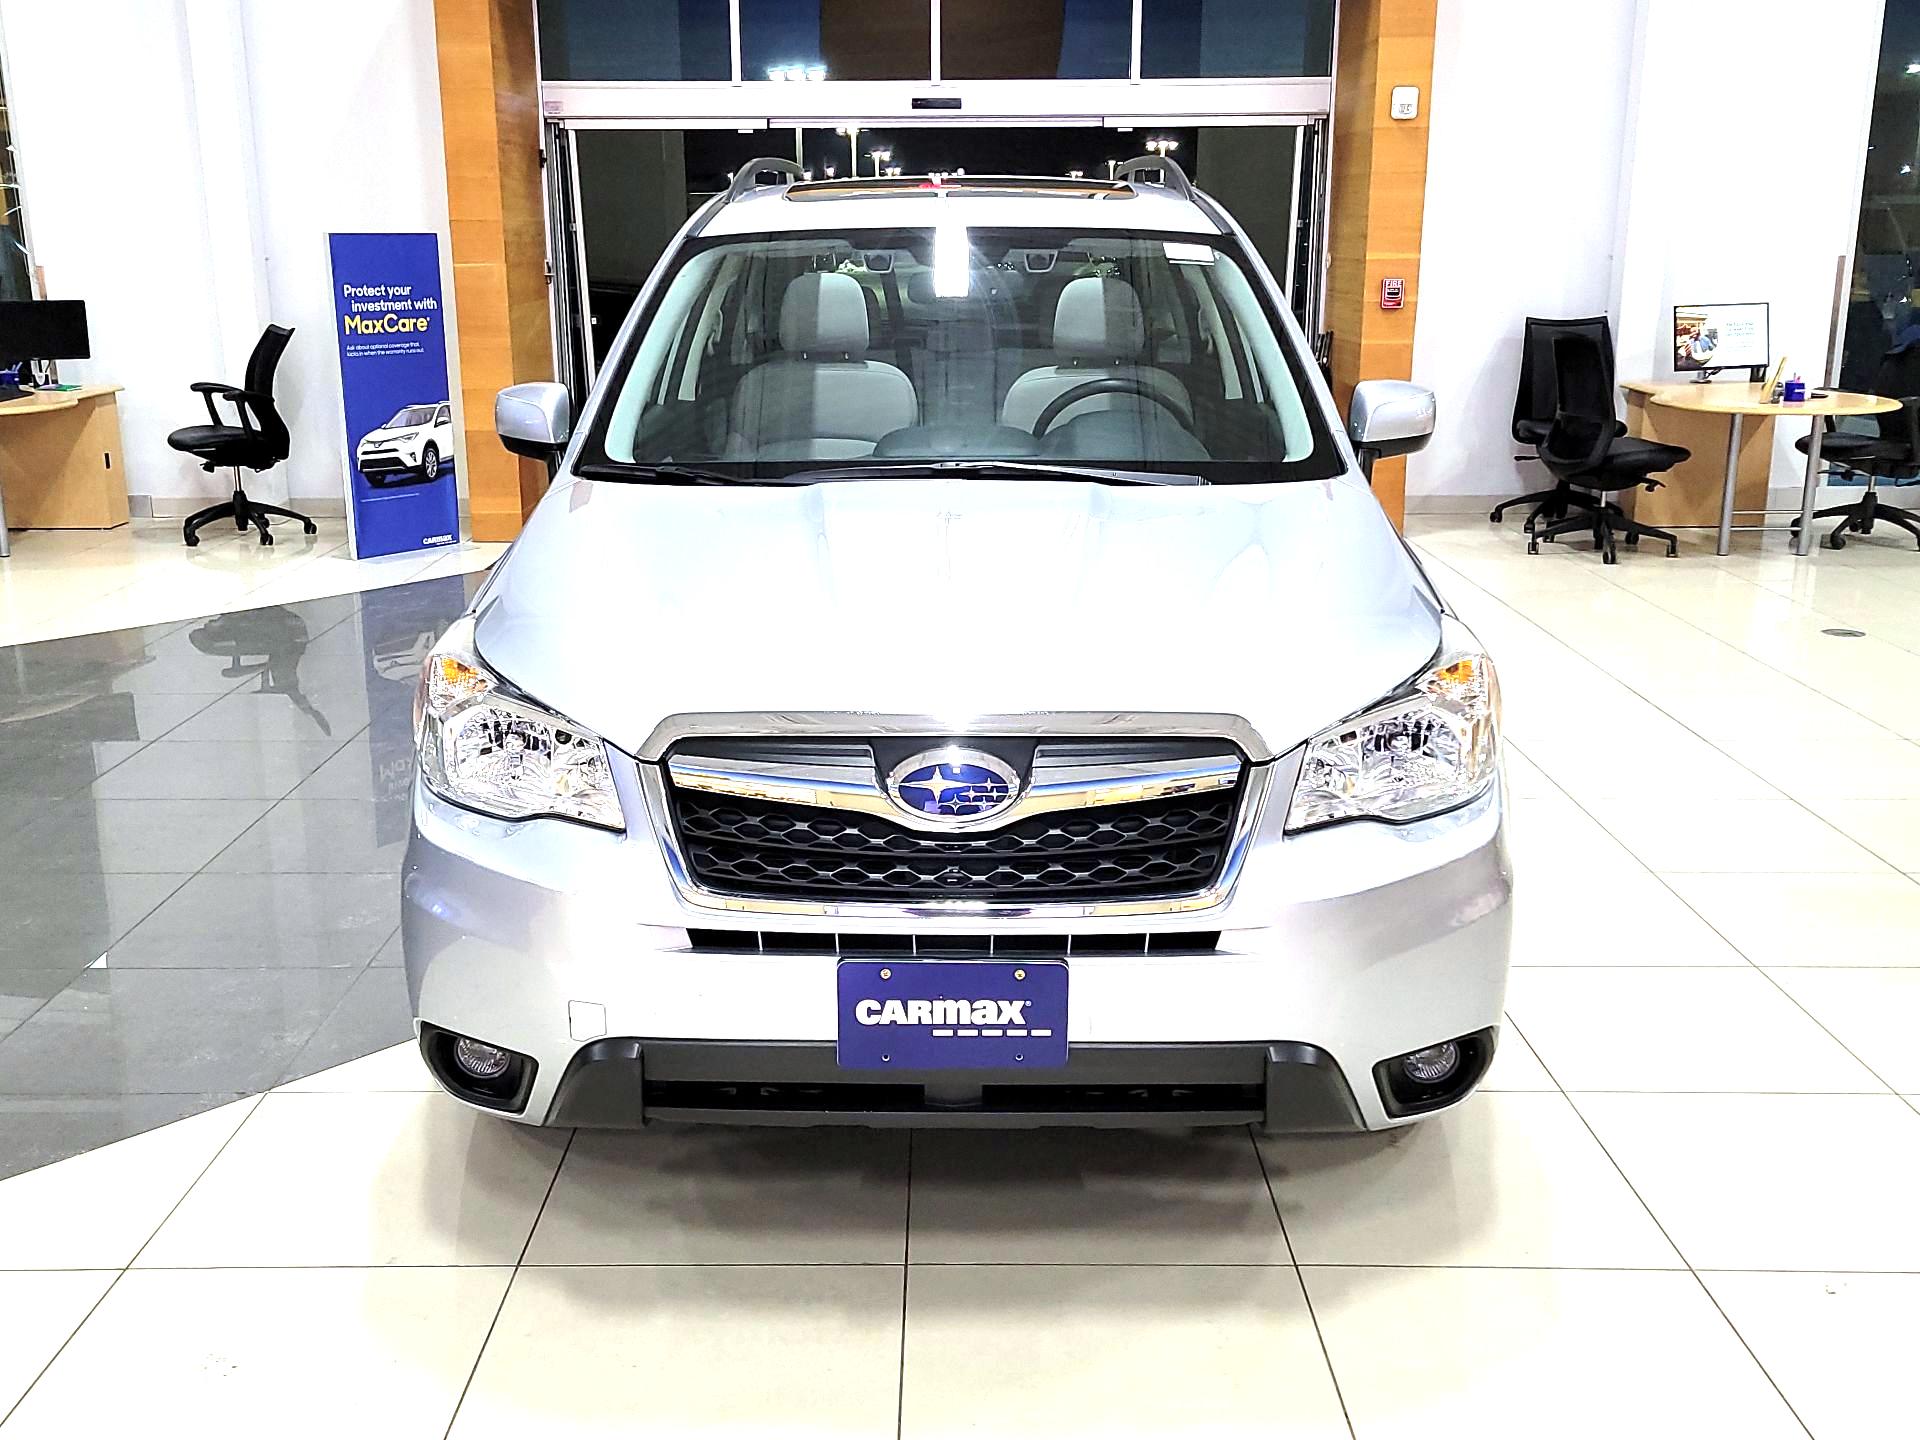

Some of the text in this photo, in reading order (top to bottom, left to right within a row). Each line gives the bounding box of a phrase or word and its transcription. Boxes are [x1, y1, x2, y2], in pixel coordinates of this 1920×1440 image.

[343, 284, 412, 299] Protect your
[351, 297, 438, 312] investment with
[344, 313, 428, 335] MaxCare
